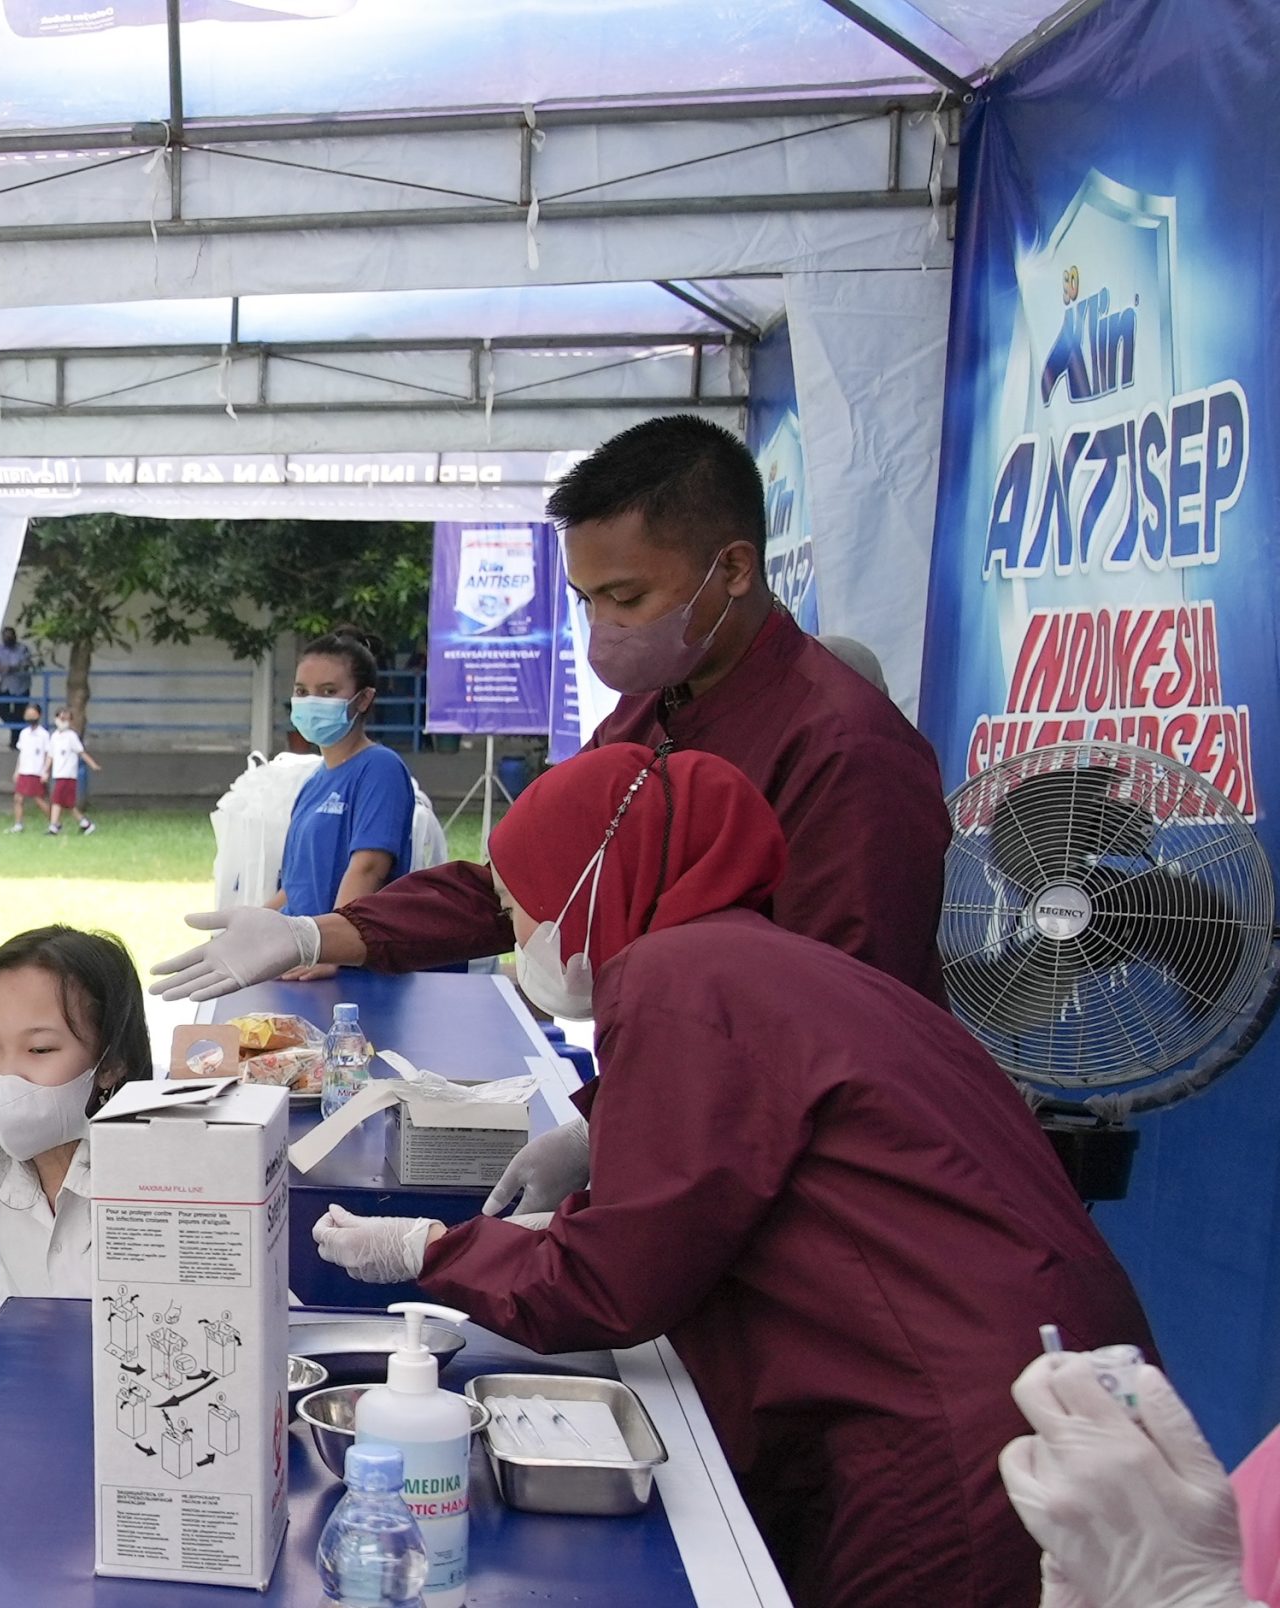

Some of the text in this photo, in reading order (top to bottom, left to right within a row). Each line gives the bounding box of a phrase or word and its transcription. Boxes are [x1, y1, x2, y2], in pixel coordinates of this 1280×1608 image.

[1062, 265, 1080, 306] SO
[983, 382, 1250, 580] ANTISEP
[465, 574, 530, 589] ANTISEP
[1005, 606, 1222, 715] INDONESIA
[1039, 906, 1086, 919] REGENCY
[138, 1185, 204, 1194] MAXIMUM FILL LINE
[404, 1474, 461, 1495] MEDIKA
